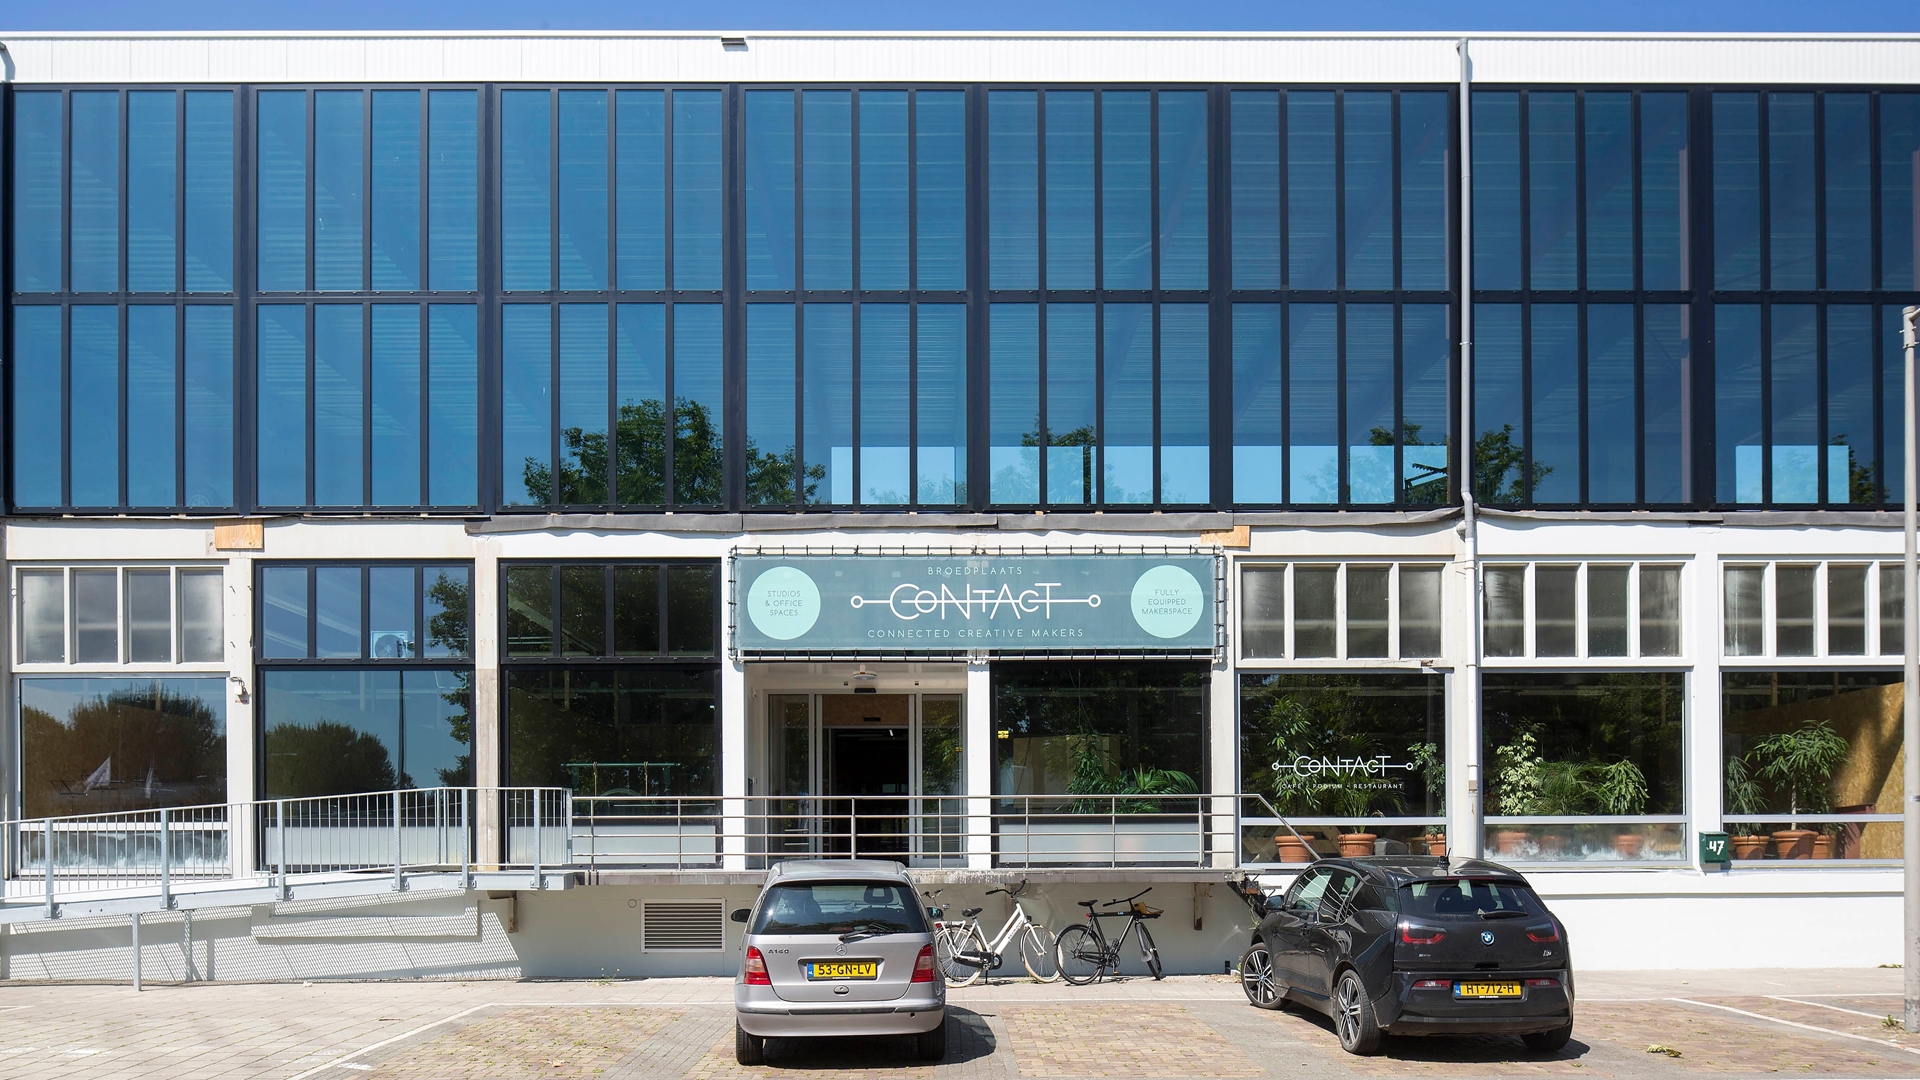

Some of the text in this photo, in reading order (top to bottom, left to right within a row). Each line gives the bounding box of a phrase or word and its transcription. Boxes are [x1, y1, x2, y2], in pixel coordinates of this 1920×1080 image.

[927, 566, 1022, 575] BROEDPLAATS
[764, 599, 803, 607] & OFFICE
[1148, 598, 1186, 606] EQUIPPED
[769, 609, 799, 617] SPACES
[867, 628, 1084, 638] CONNECTED CREATIVE MAKERS
[1709, 840, 1725, 856] 47
[818, 964, 871, 975] 53-GN-LV
[1466, 983, 1515, 994] HT-712-H
